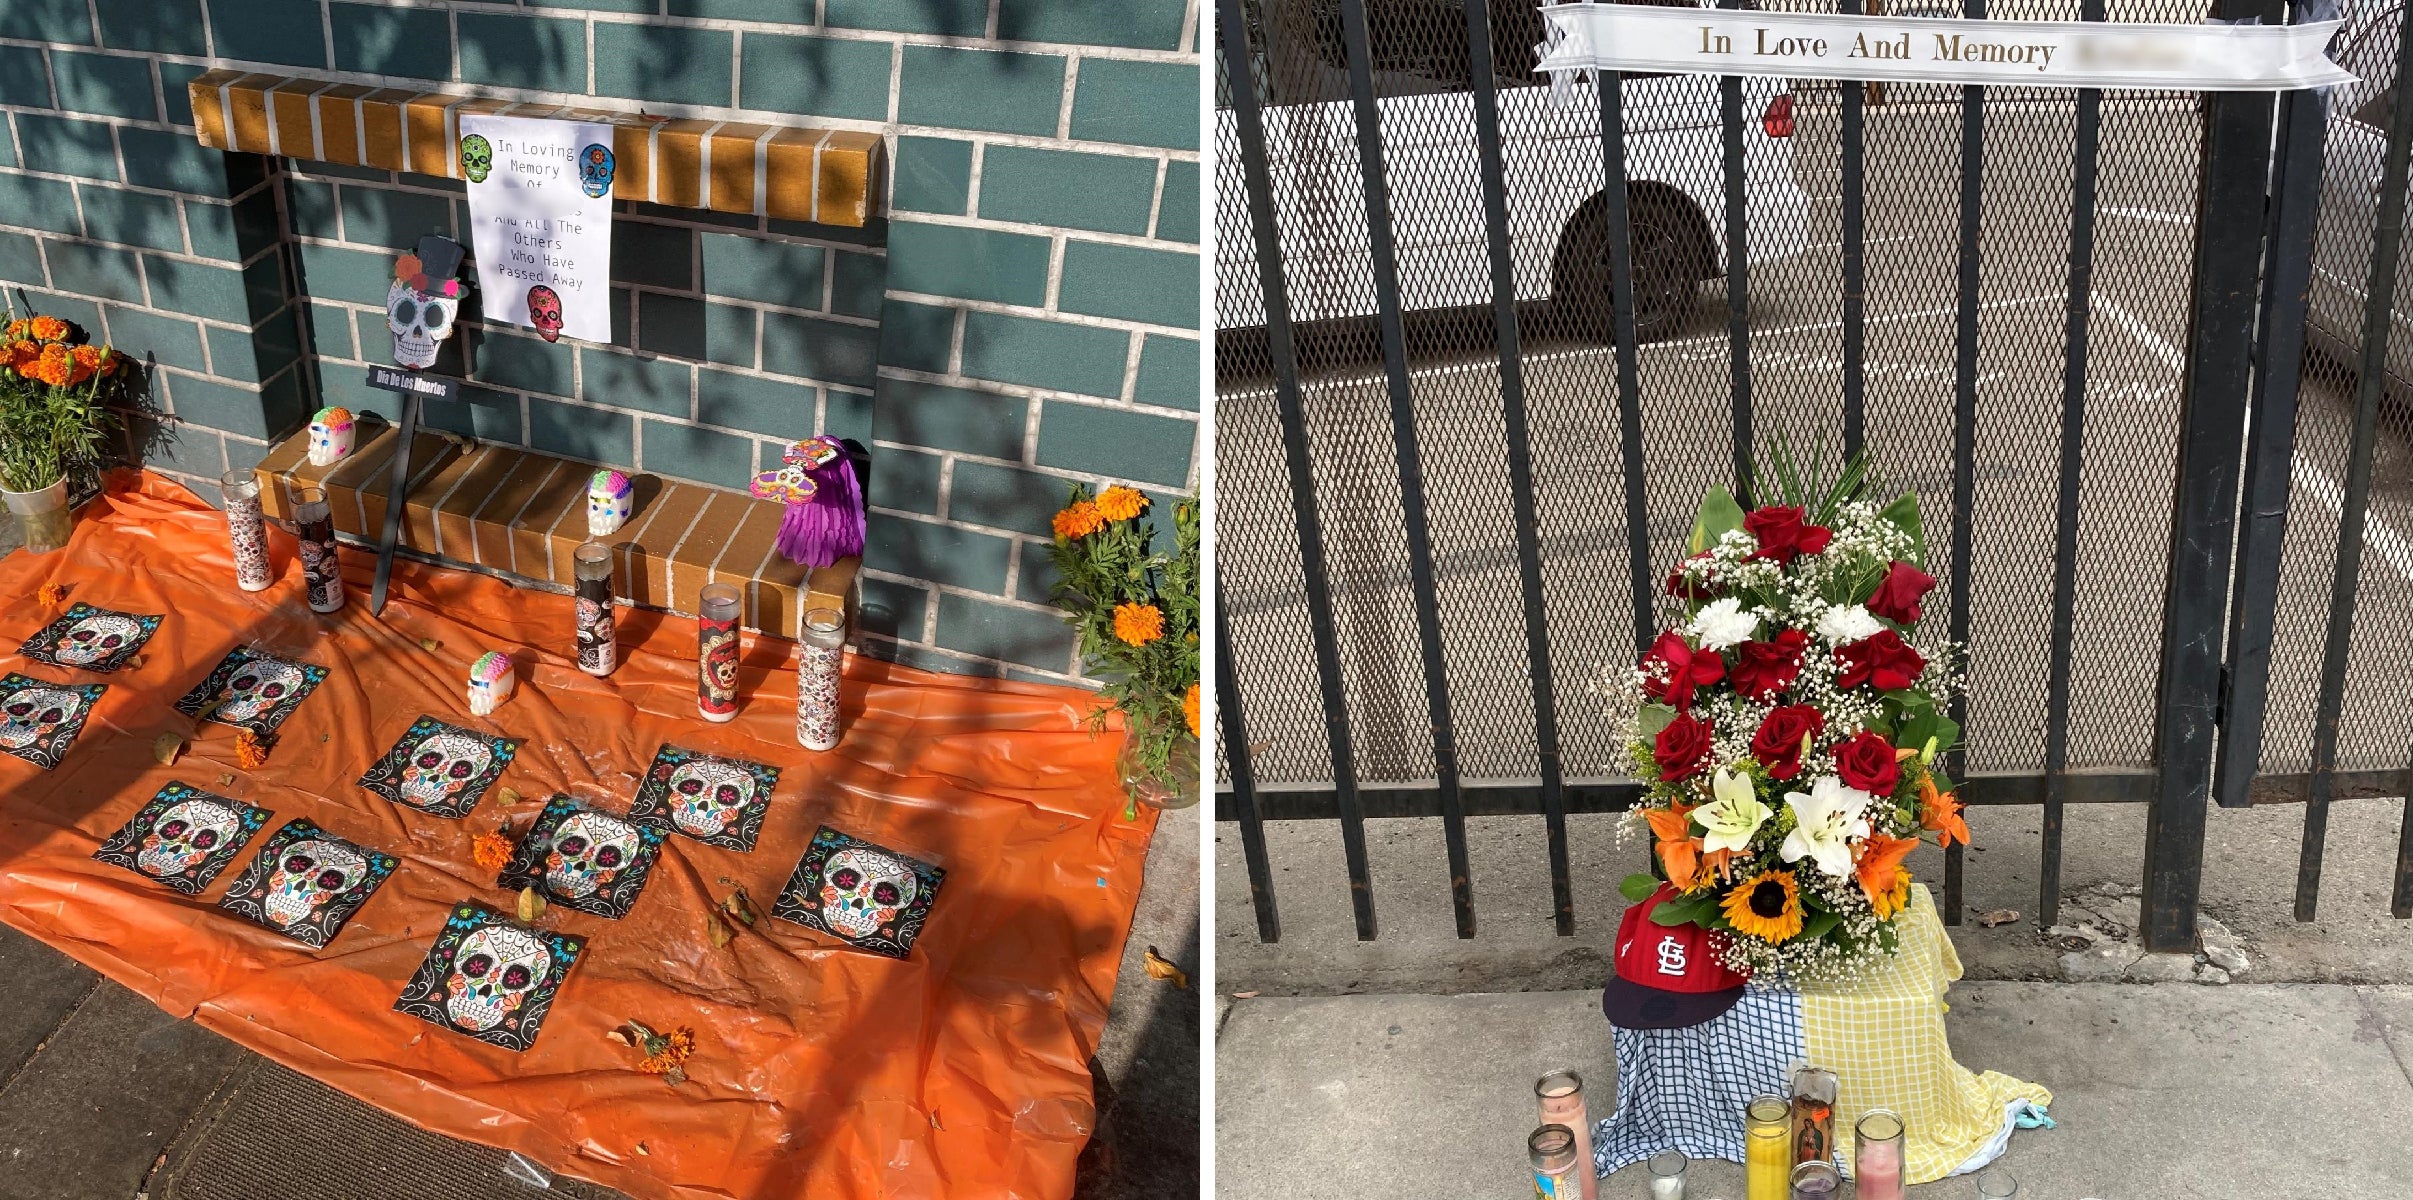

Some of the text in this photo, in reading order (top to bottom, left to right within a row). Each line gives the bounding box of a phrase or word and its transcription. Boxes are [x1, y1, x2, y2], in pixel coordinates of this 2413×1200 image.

[1697, 26, 1734, 54] In
[1753, 28, 1828, 58] Love
[1848, 31, 1911, 60] And
[1932, 33, 2057, 71] Memory
[498, 139, 575, 162] In Loving
[510, 159, 560, 180] Memory
[557, 219, 582, 235] The
[514, 231, 562, 250] Others
[511, 248, 575, 270] Who Have
[498, 263, 583, 291] Passed Away
[390, 372, 401, 387] De
[401, 374, 414, 391] Los
[414, 377, 447, 397] Muertos
